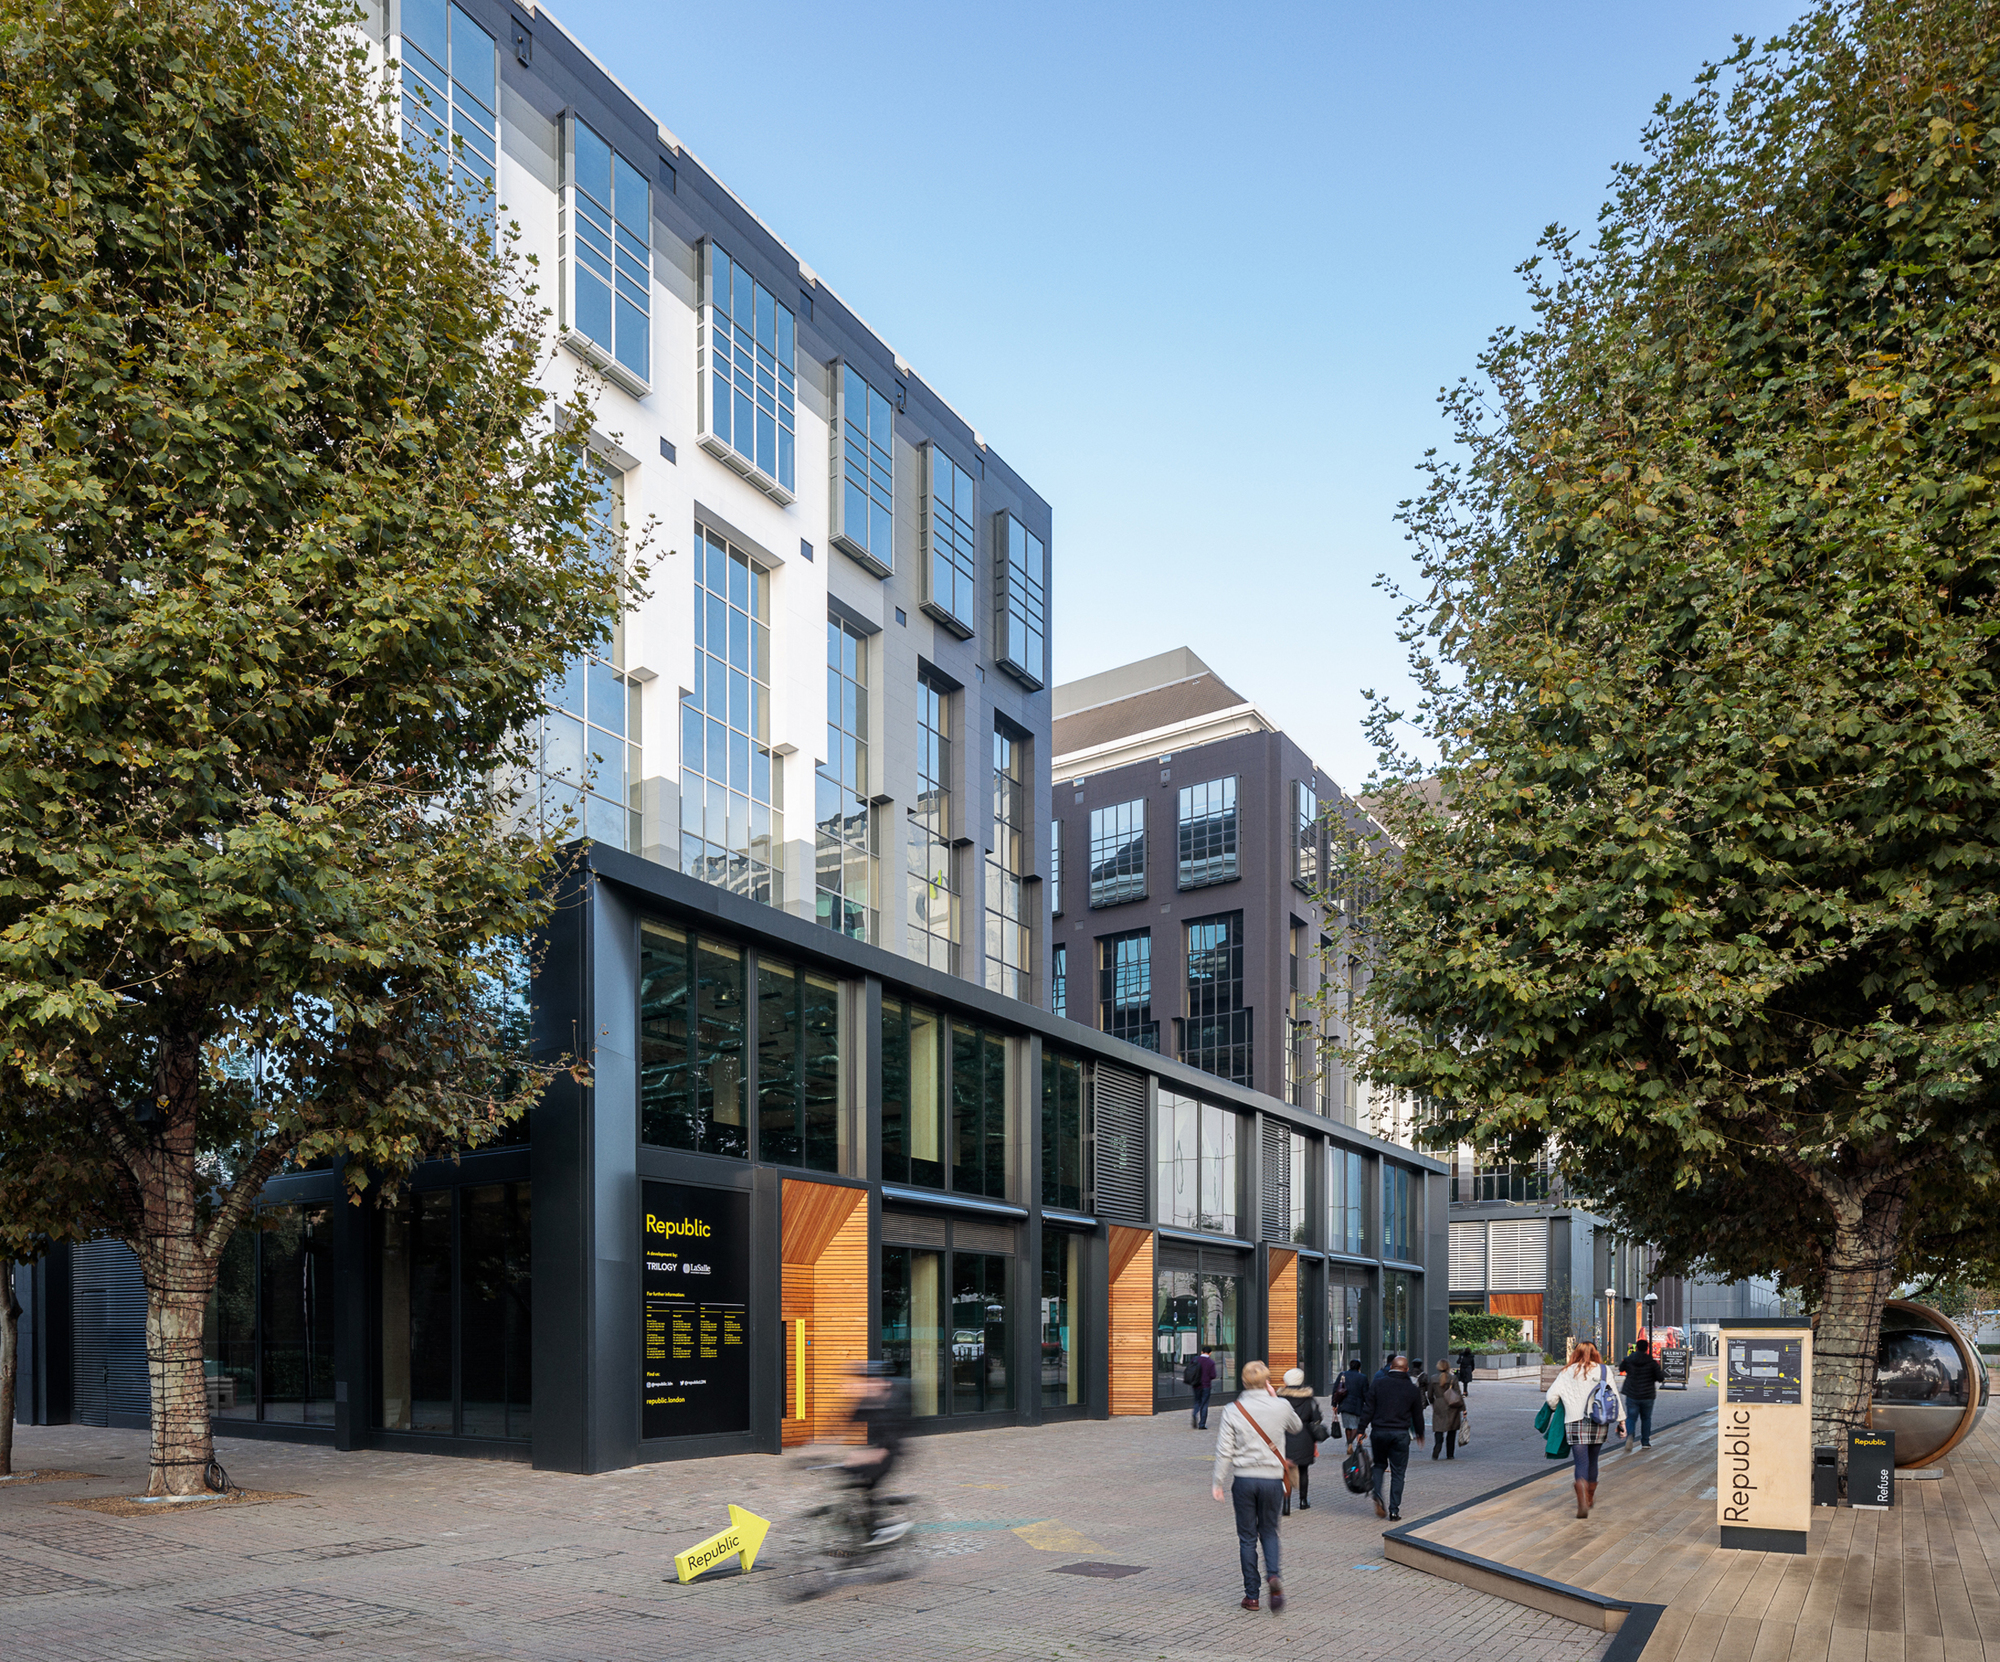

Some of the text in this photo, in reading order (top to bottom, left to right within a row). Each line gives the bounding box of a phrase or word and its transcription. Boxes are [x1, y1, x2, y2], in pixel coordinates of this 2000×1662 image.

[646, 1213, 711, 1240] Republic
[646, 1262, 677, 1271] TRILOGY
[646, 1396, 685, 1405] republic.london
[1854, 1438, 1886, 1446] Republic
[1723, 1410, 1758, 1522] Republic
[1876, 1468, 1889, 1502] Refuse
[687, 1536, 740, 1571] Republic
